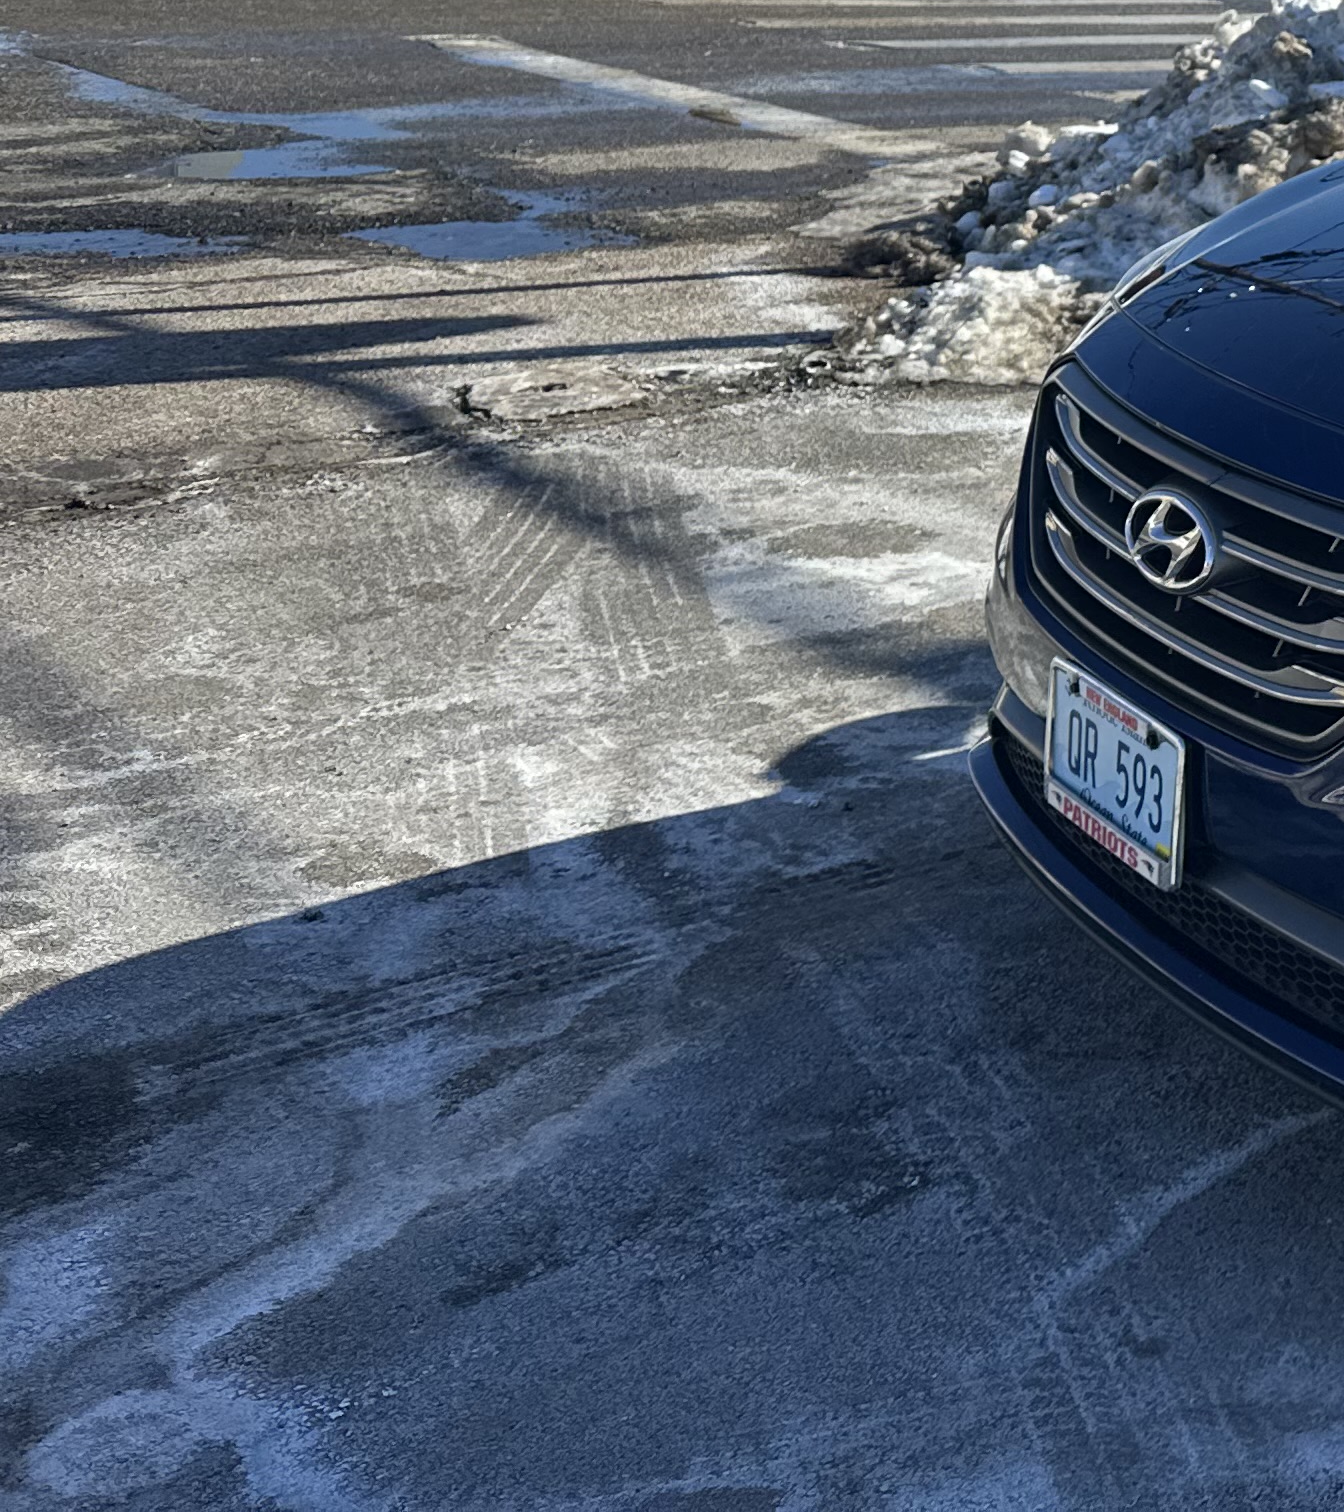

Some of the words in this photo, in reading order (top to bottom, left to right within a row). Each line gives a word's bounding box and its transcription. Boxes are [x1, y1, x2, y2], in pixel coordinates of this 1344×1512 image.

[1085, 685, 1102, 707] NEW
[1103, 697, 1139, 732] ENGLAND
[1066, 708, 1099, 789] QR
[1115, 739, 1163, 834] 593
[1063, 796, 1139, 869] PATRIOTS
[1080, 787, 1114, 822] Ocean
[1121, 813, 1148, 846] State
